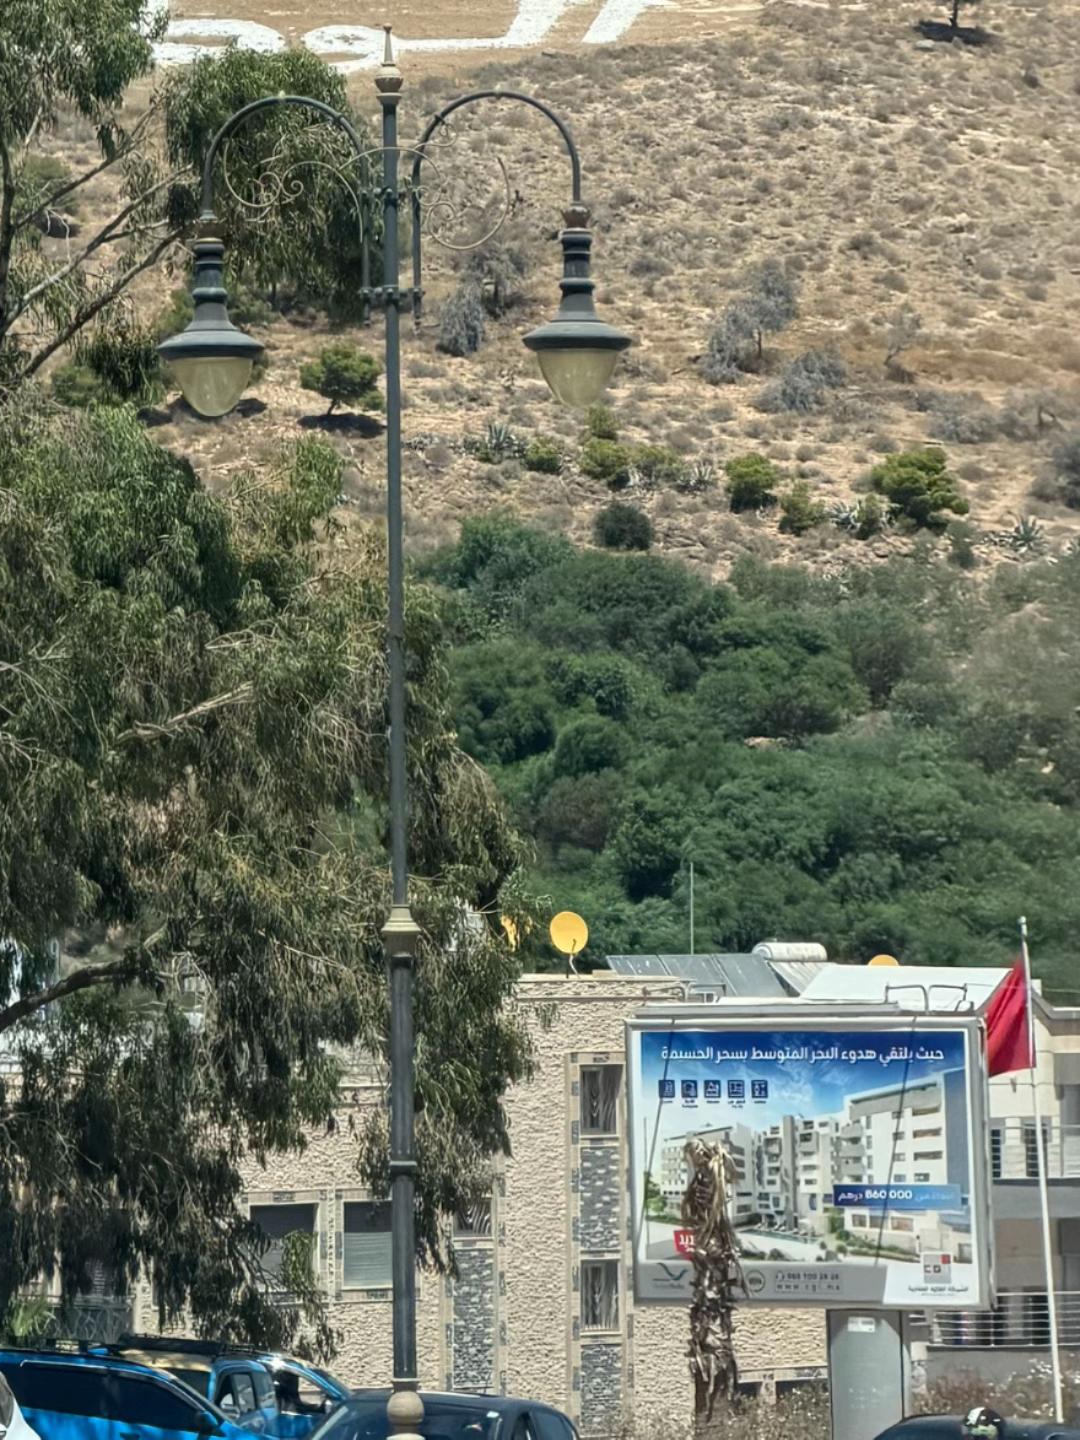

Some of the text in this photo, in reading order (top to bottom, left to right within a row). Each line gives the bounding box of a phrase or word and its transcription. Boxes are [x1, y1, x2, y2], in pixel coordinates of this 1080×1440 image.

[715, 1048, 748, 1063] بسحر
[751, 1046, 808, 1063] المتوسط
[810, 1047, 838, 1063] البحر
[841, 1048, 877, 1063] هدوء
[880, 1047, 913, 1067] يلتقي
[915, 1046, 945, 1062] حيث
